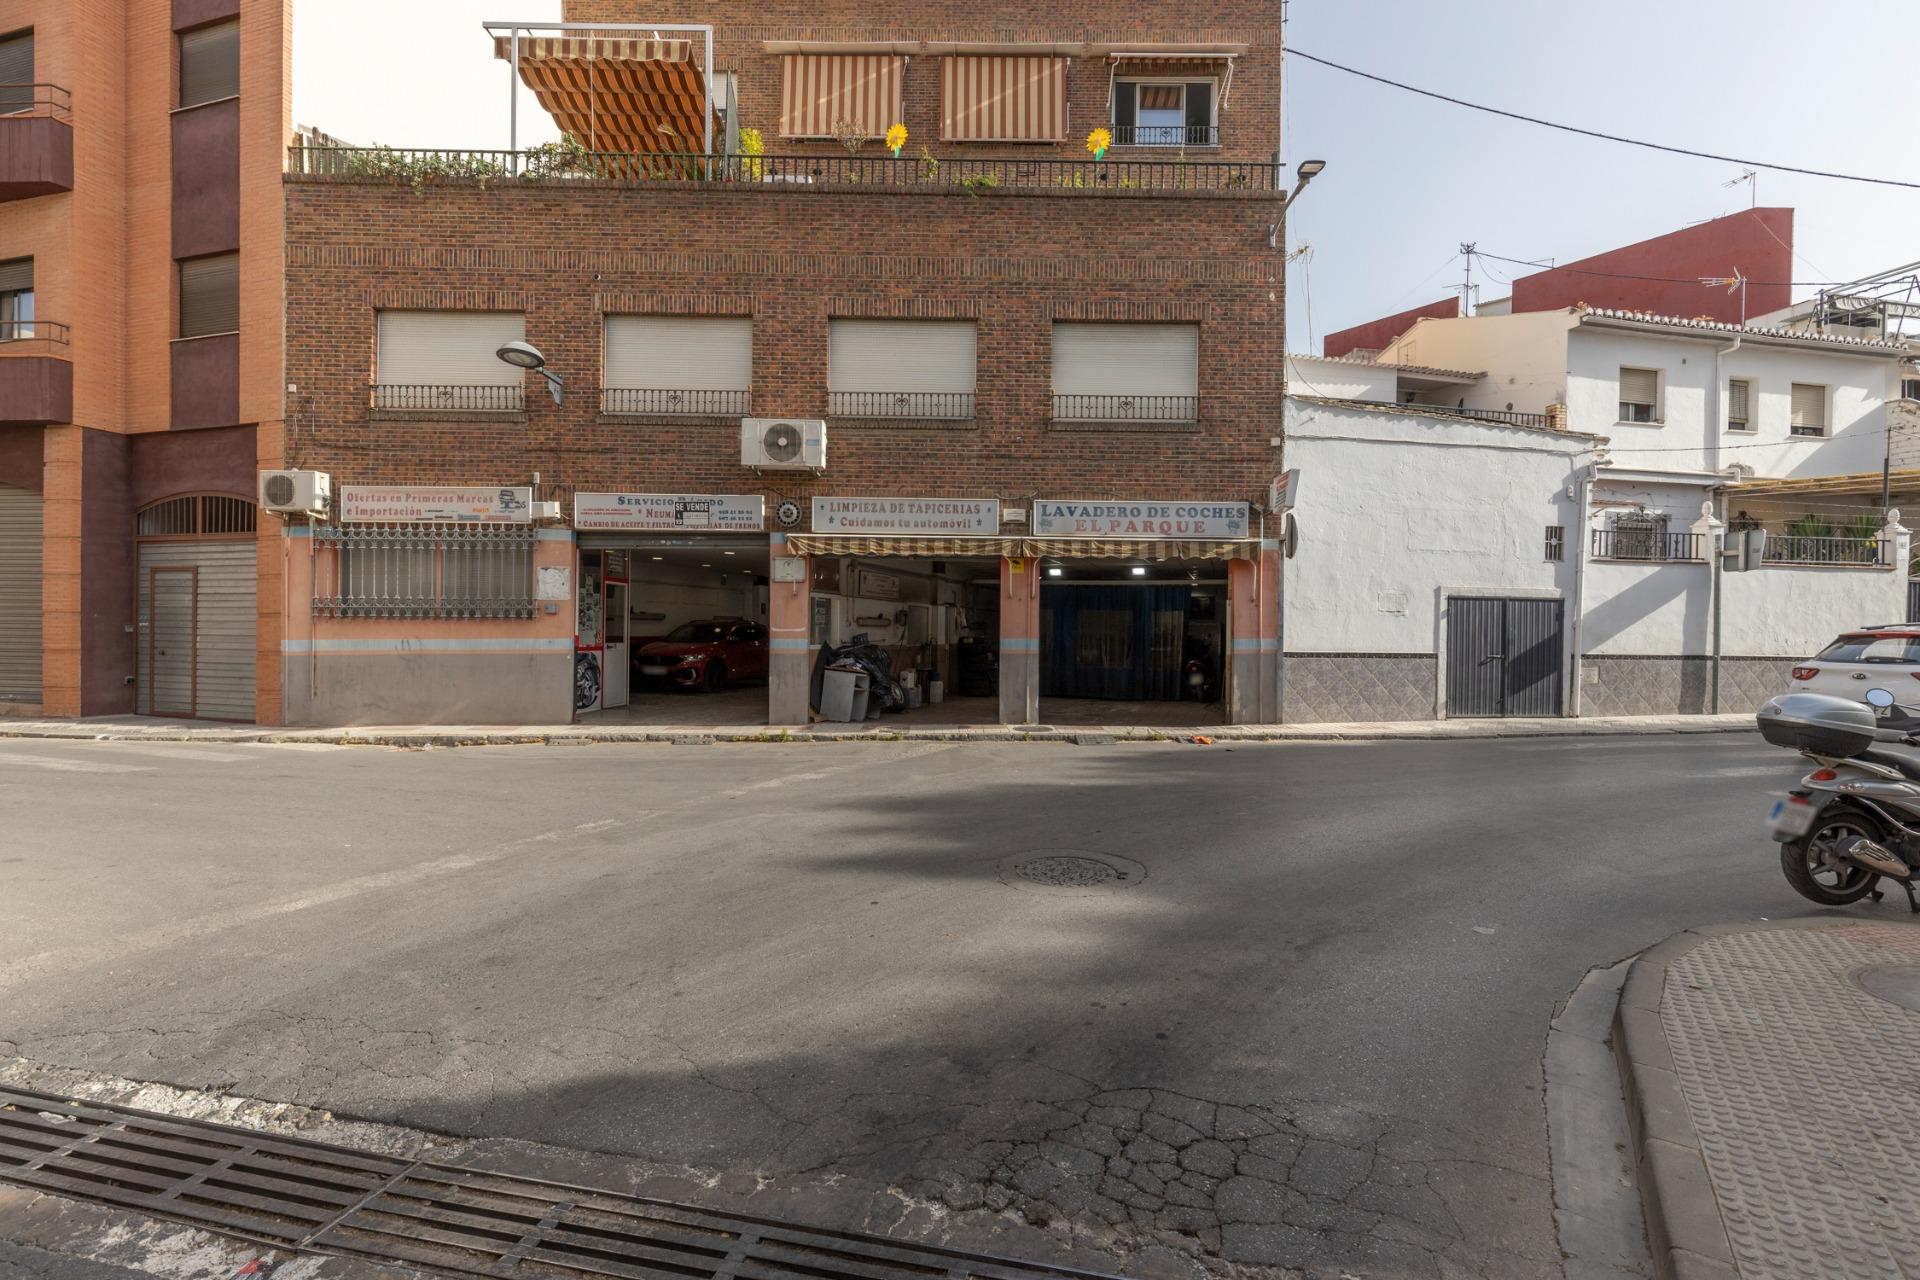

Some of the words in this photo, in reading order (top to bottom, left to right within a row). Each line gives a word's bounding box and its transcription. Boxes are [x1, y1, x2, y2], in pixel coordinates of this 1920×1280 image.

[347, 492, 387, 502] Ofertas
[390, 494, 402, 502] en
[405, 493, 455, 503] Primeras
[457, 494, 494, 503] Marcas
[617, 496, 674, 506] SERVICIO
[346, 507, 352, 516] e
[355, 505, 422, 517] Importación
[675, 502, 684, 511] SE
[686, 503, 709, 512] VENDE
[829, 501, 887, 514] LIMPIEZA
[889, 502, 905, 514] DE
[907, 503, 981, 515] TAPICERIAS
[1040, 504, 1142, 518] LAVADERO
[1147, 506, 1171, 518] DE
[1175, 507, 1246, 519] COCHES
[840, 517, 895, 528] Cuidamos
[898, 518, 911, 528] tu
[1075, 519, 1102, 533] EL
[1110, 519, 1206, 535] PARQUE
